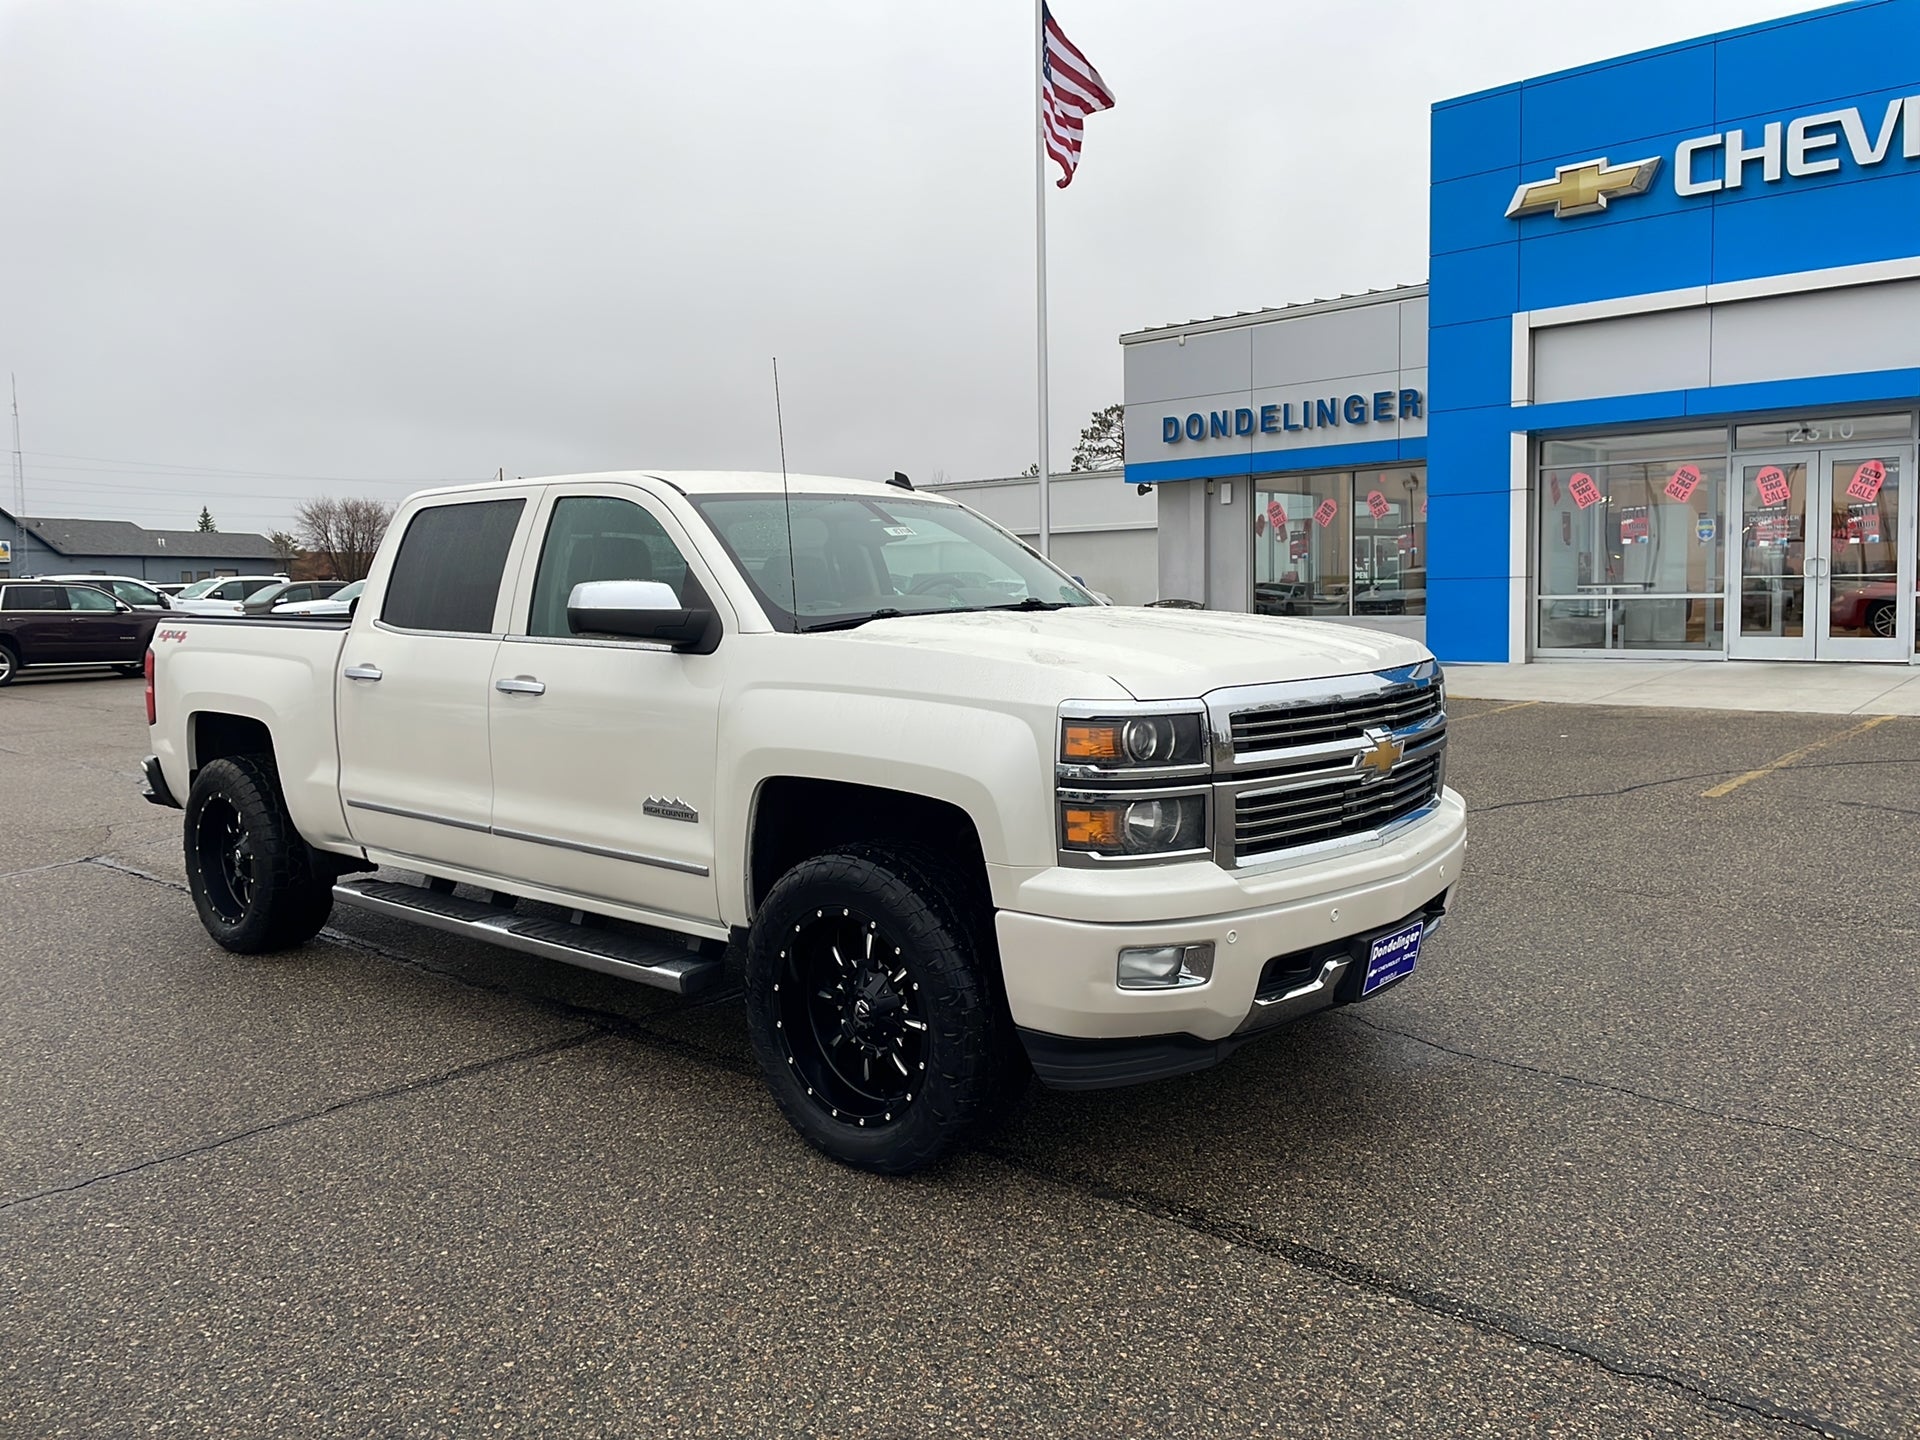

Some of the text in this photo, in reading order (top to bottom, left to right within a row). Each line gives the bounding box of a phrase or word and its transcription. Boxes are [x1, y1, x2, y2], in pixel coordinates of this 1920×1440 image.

[1162, 388, 1423, 444] DONDELINGER
[1678, 469, 1697, 482] RED
[1760, 472, 1780, 484] RED
[1860, 467, 1882, 479] RED
[1572, 477, 1588, 490] RED
[1675, 477, 1691, 489] TAG
[1763, 480, 1782, 491] TAG
[1859, 475, 1877, 487] TAG
[1576, 485, 1591, 496] TAG
[1666, 484, 1688, 501] SALE
[1764, 488, 1789, 504] SALE
[1849, 483, 1875, 500] SALE
[1578, 490, 1599, 508] SALE
[1374, 504, 1390, 518] SALE
[1273, 515, 1286, 527] SALE
[1314, 512, 1329, 525] SALE
[643, 806, 695, 819] HIGH COUNTRY
[1372, 931, 1419, 960] Dondelinger
